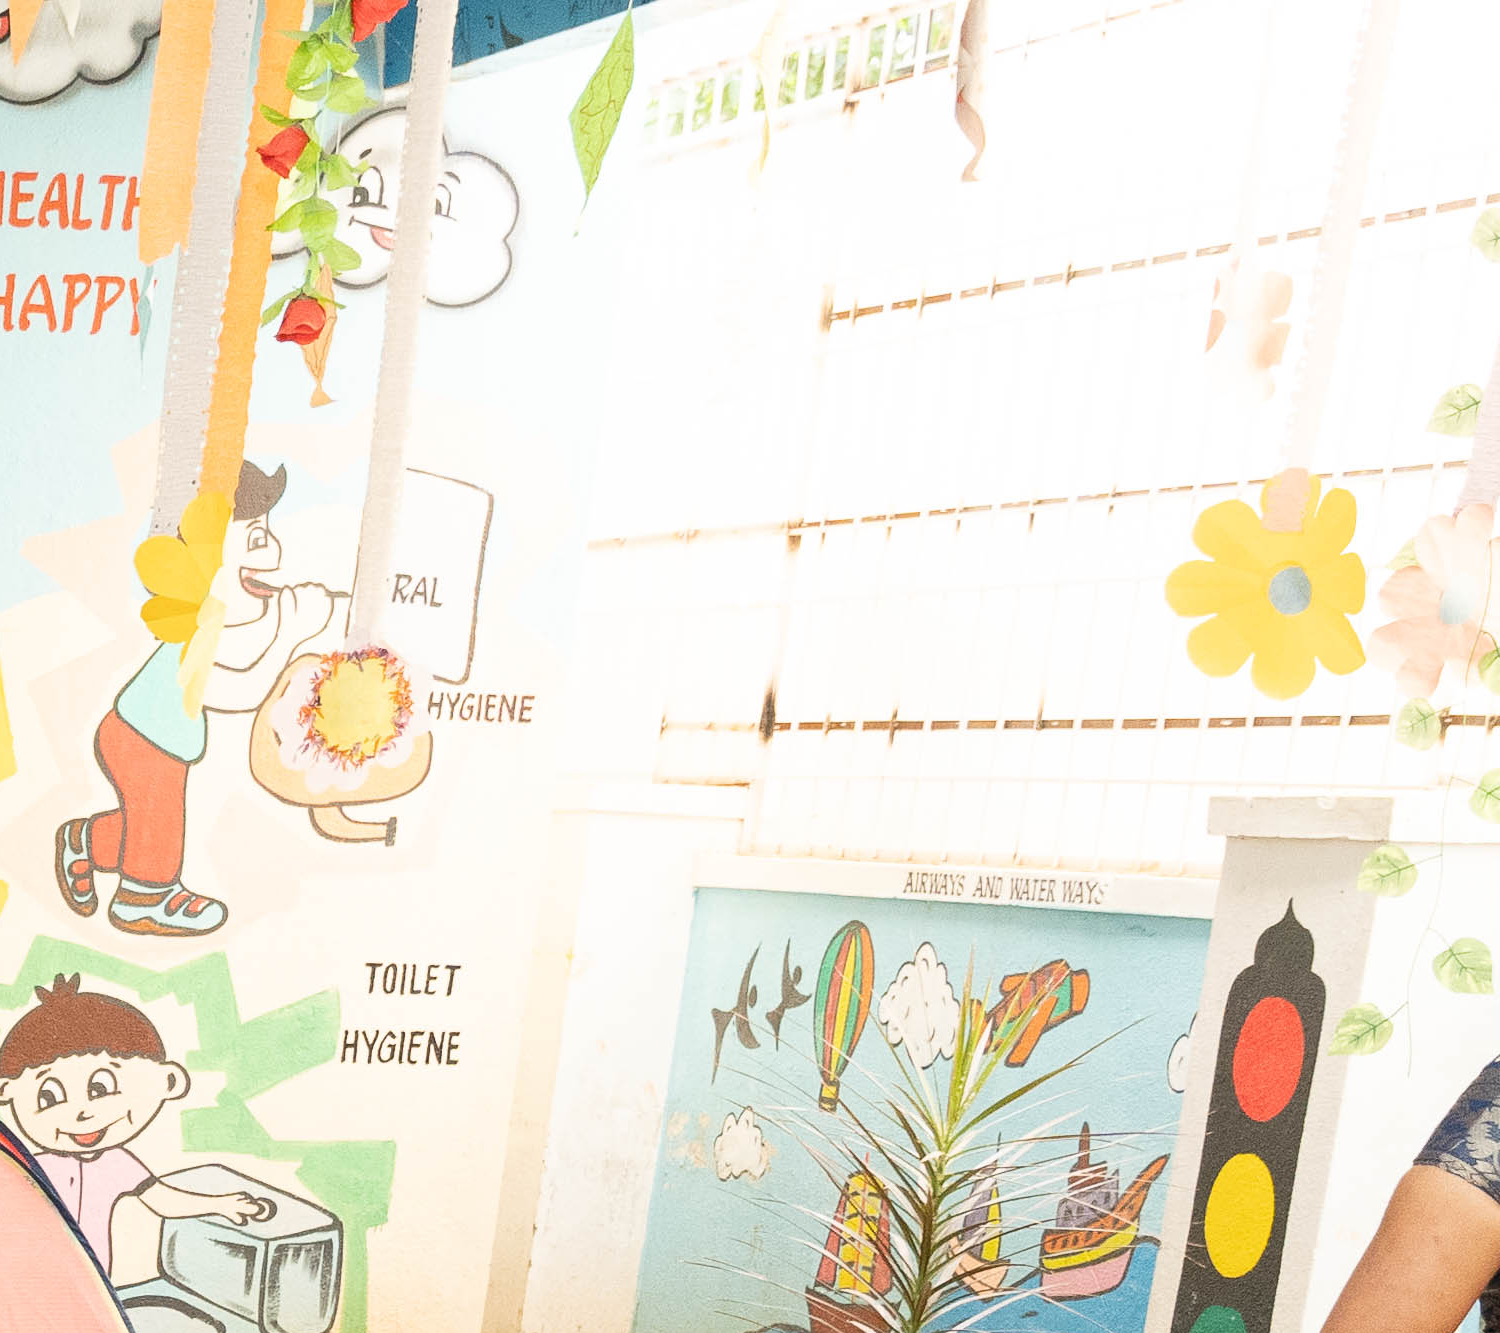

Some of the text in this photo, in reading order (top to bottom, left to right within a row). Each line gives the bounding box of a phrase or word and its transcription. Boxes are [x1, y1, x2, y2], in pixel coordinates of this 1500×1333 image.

[388, 573, 443, 608] RAL
[427, 691, 536, 723] HYGIENE
[903, 870, 965, 897] AIRWAYS
[972, 875, 1003, 899] AND
[1009, 876, 1056, 902] WATER
[364, 962, 462, 997] TOILET
[340, 1029, 461, 1066] HYGIENE
